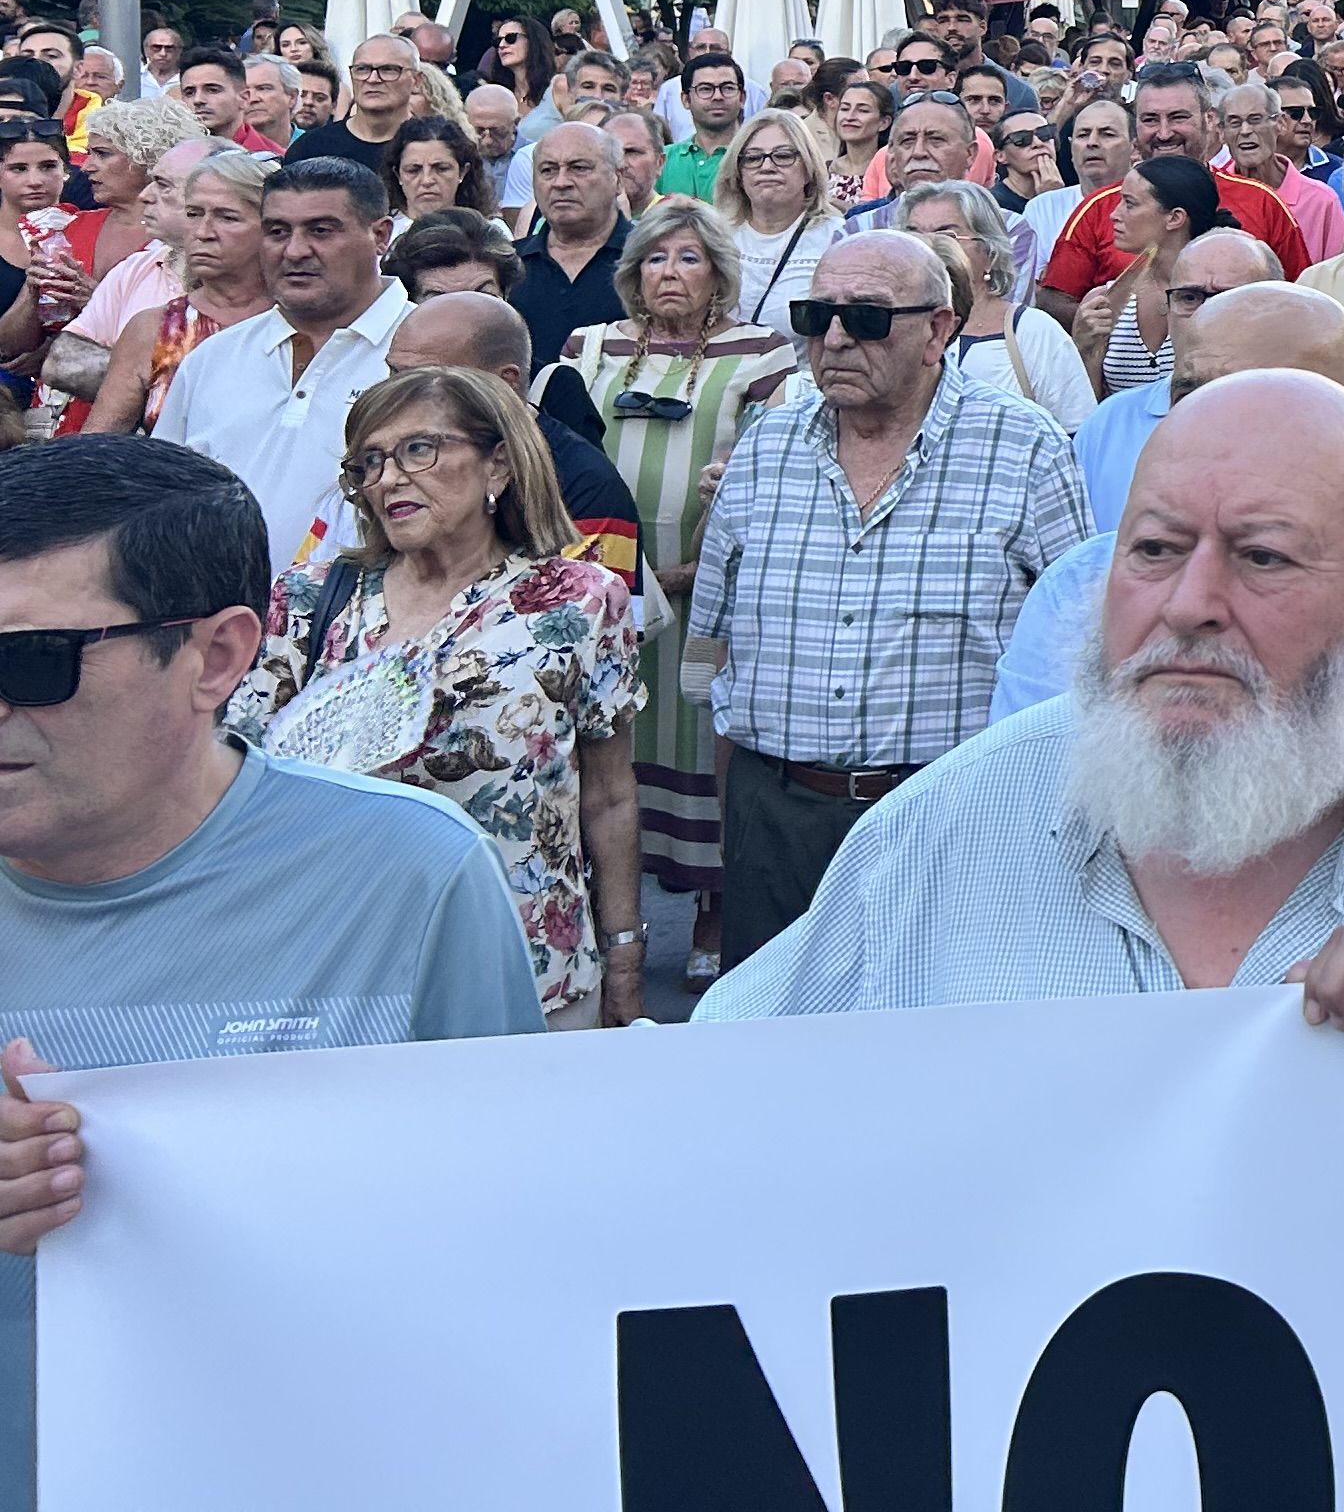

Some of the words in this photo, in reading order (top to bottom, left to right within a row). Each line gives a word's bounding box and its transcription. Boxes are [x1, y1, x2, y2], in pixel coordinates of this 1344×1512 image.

[219, 1018, 266, 1034] JOHN
[266, 1016, 320, 1031] SMITH
[217, 1033, 265, 1045] OFFICIAL
[270, 1032, 318, 1042] PRODUCT
